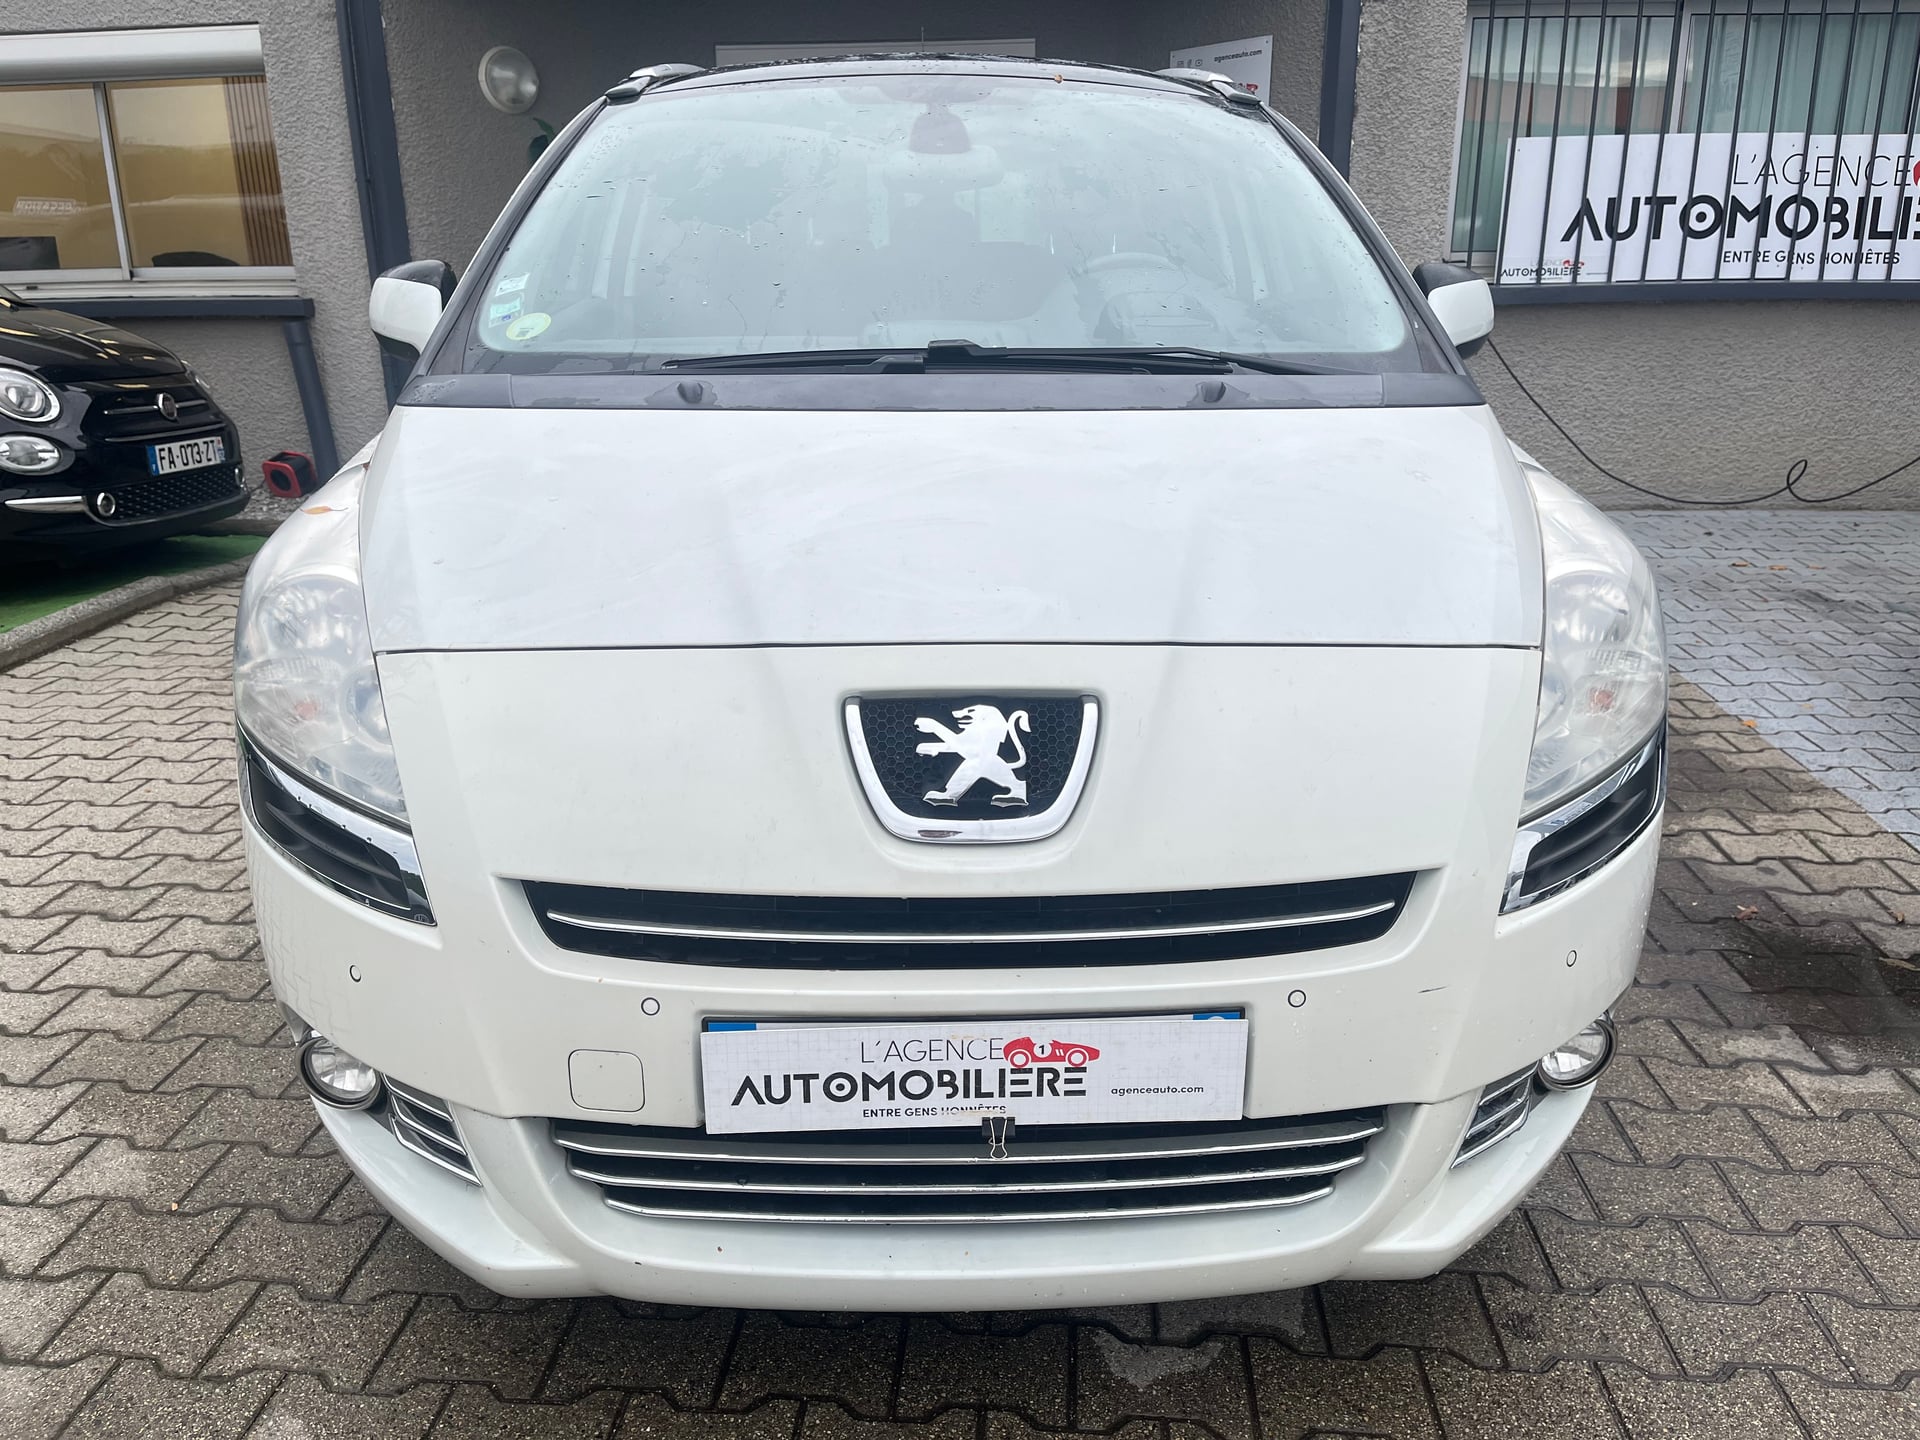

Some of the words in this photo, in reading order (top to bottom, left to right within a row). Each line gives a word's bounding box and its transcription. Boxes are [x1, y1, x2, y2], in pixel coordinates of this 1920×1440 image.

[1214, 49, 1262, 62] agenceauto.com
[1733, 153, 1915, 187] L'AGENCE
[1560, 193, 1920, 242] AUTOMOBILI
[1723, 250, 1771, 263] ENTRE
[158, 440, 218, 471] FA-073-ZT
[861, 1038, 1004, 1064] L'AGENCE
[1038, 1044, 1046, 1055] 1
[1110, 1084, 1205, 1098] agenceauto.com
[863, 1108, 902, 1118] ENTRE
[904, 1107, 938, 1117] GENS
